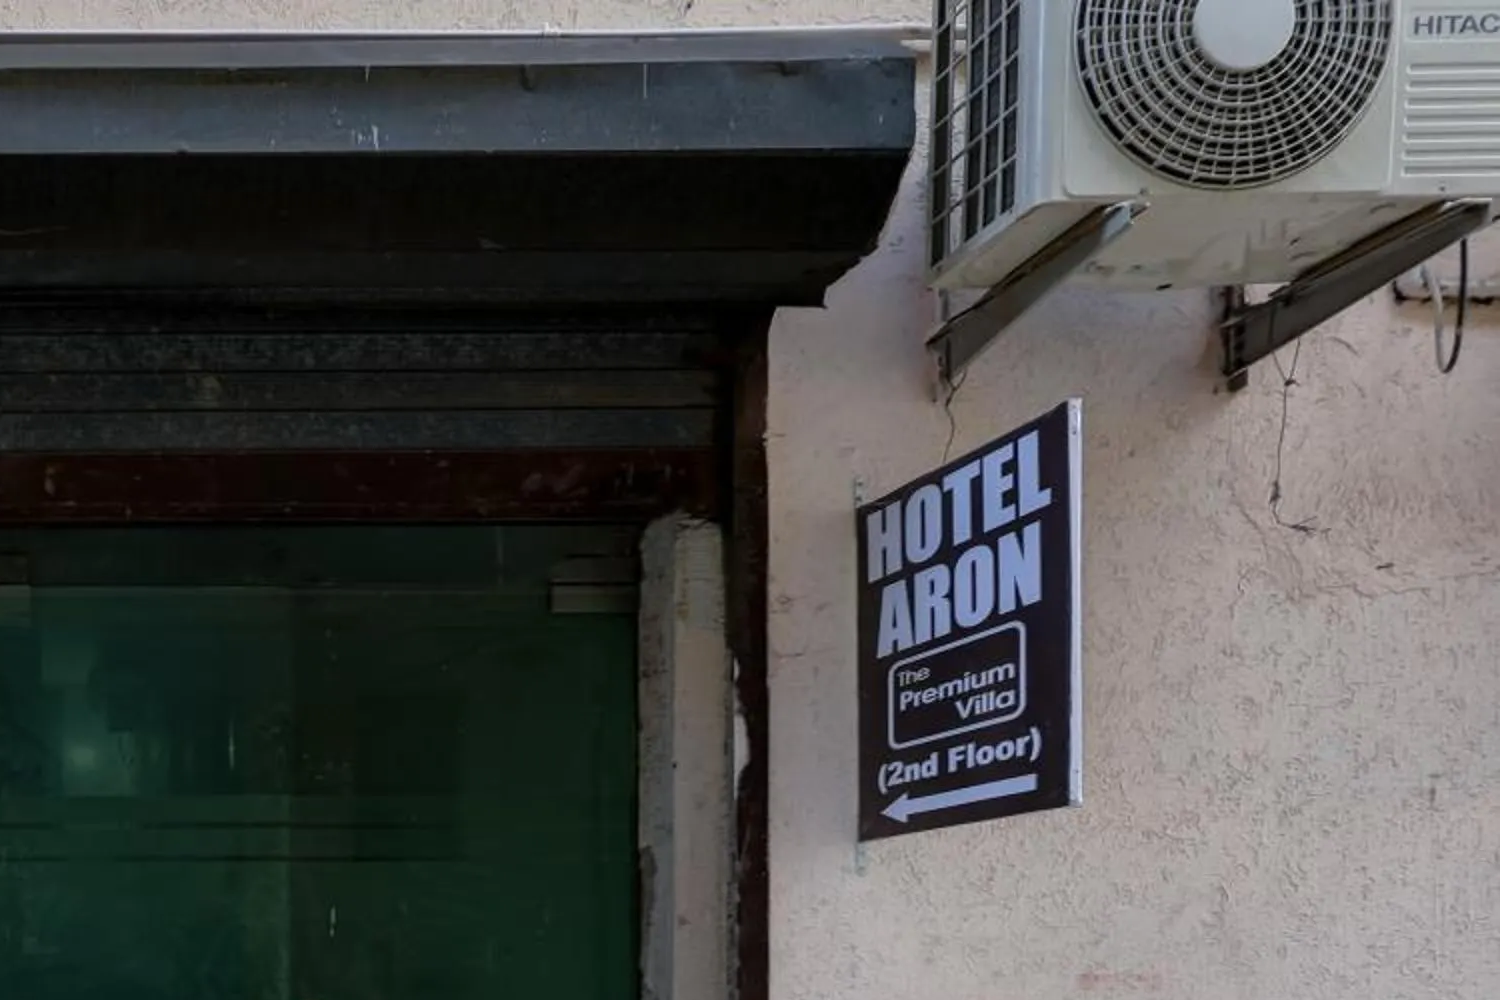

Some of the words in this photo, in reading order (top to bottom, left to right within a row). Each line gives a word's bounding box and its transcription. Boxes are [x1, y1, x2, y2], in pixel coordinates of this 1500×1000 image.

[1414, 13, 1500, 35] HITAC
[867, 430, 1052, 583] HOTEL
[876, 520, 1042, 659] ARON
[897, 667, 931, 687] The
[899, 662, 1016, 711] Premium
[955, 689, 1016, 720] Villa
[877, 752, 938, 795] (2nd
[948, 726, 1042, 773] Floor)
